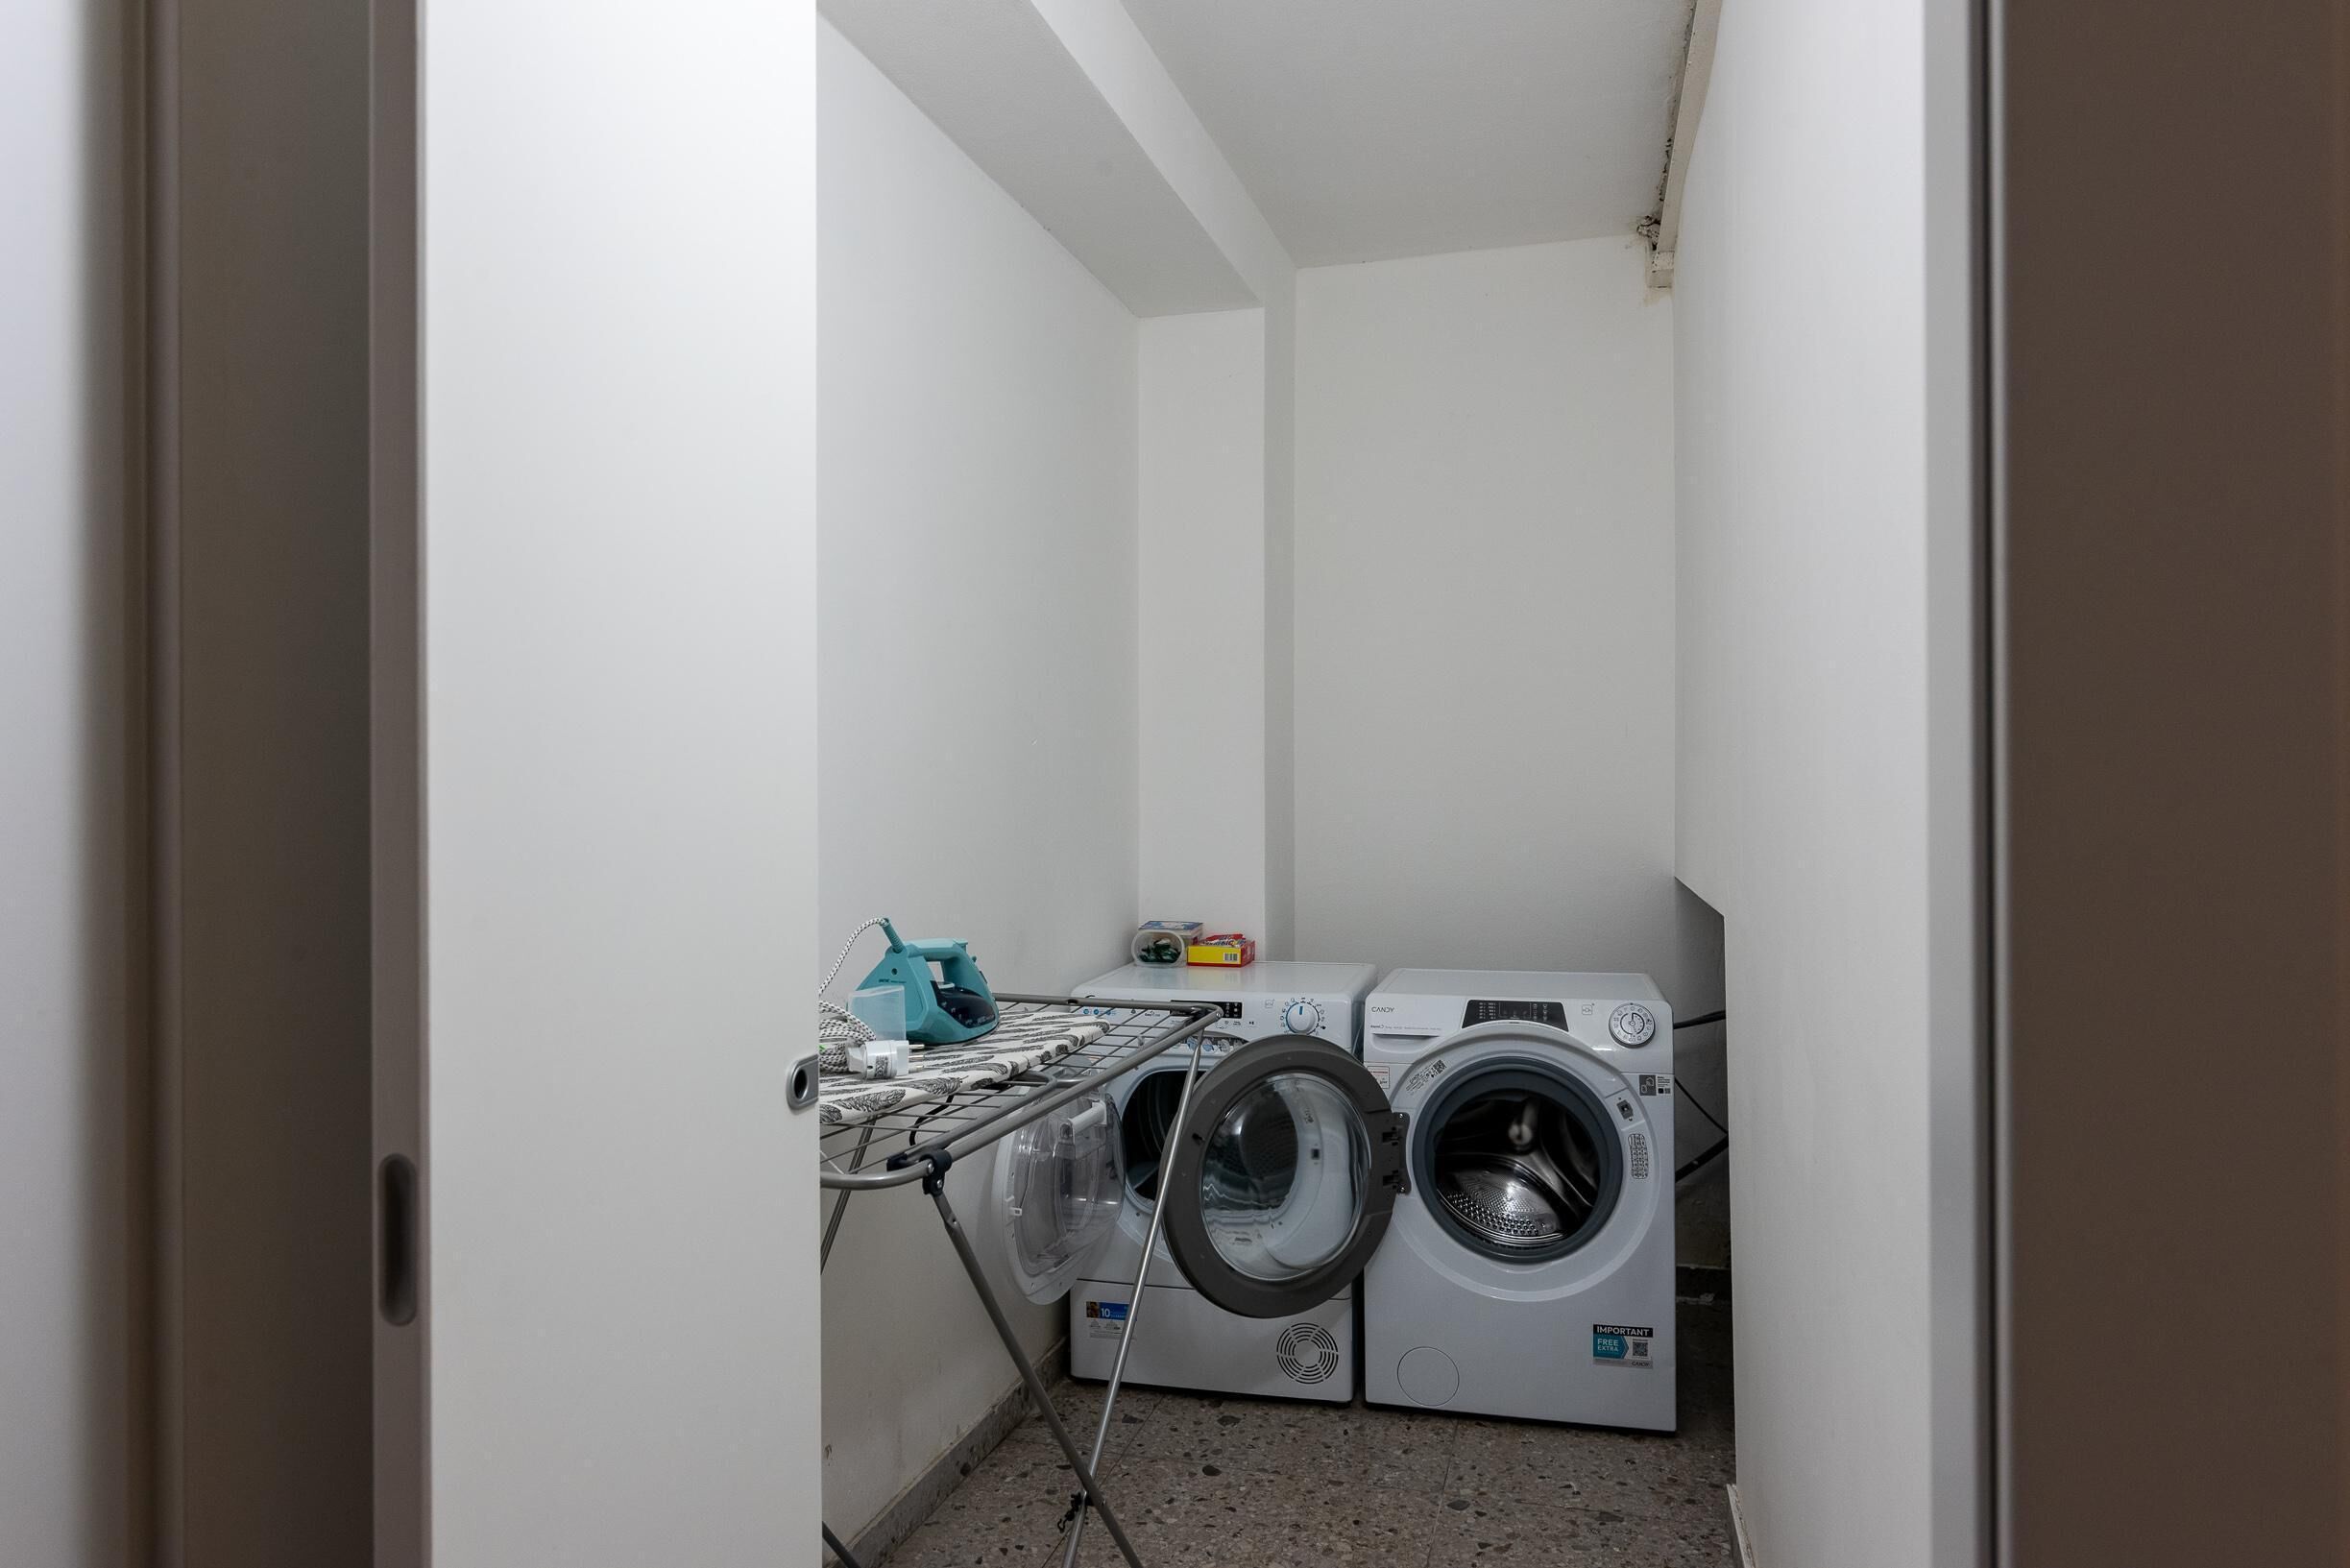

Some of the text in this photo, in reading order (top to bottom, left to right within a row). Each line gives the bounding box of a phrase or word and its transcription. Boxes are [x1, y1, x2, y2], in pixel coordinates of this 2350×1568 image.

[1101, 1308, 1111, 1317] 10
[1596, 1326, 1650, 1336] IMPORTANT
[1597, 1338, 1619, 1346] FREE
